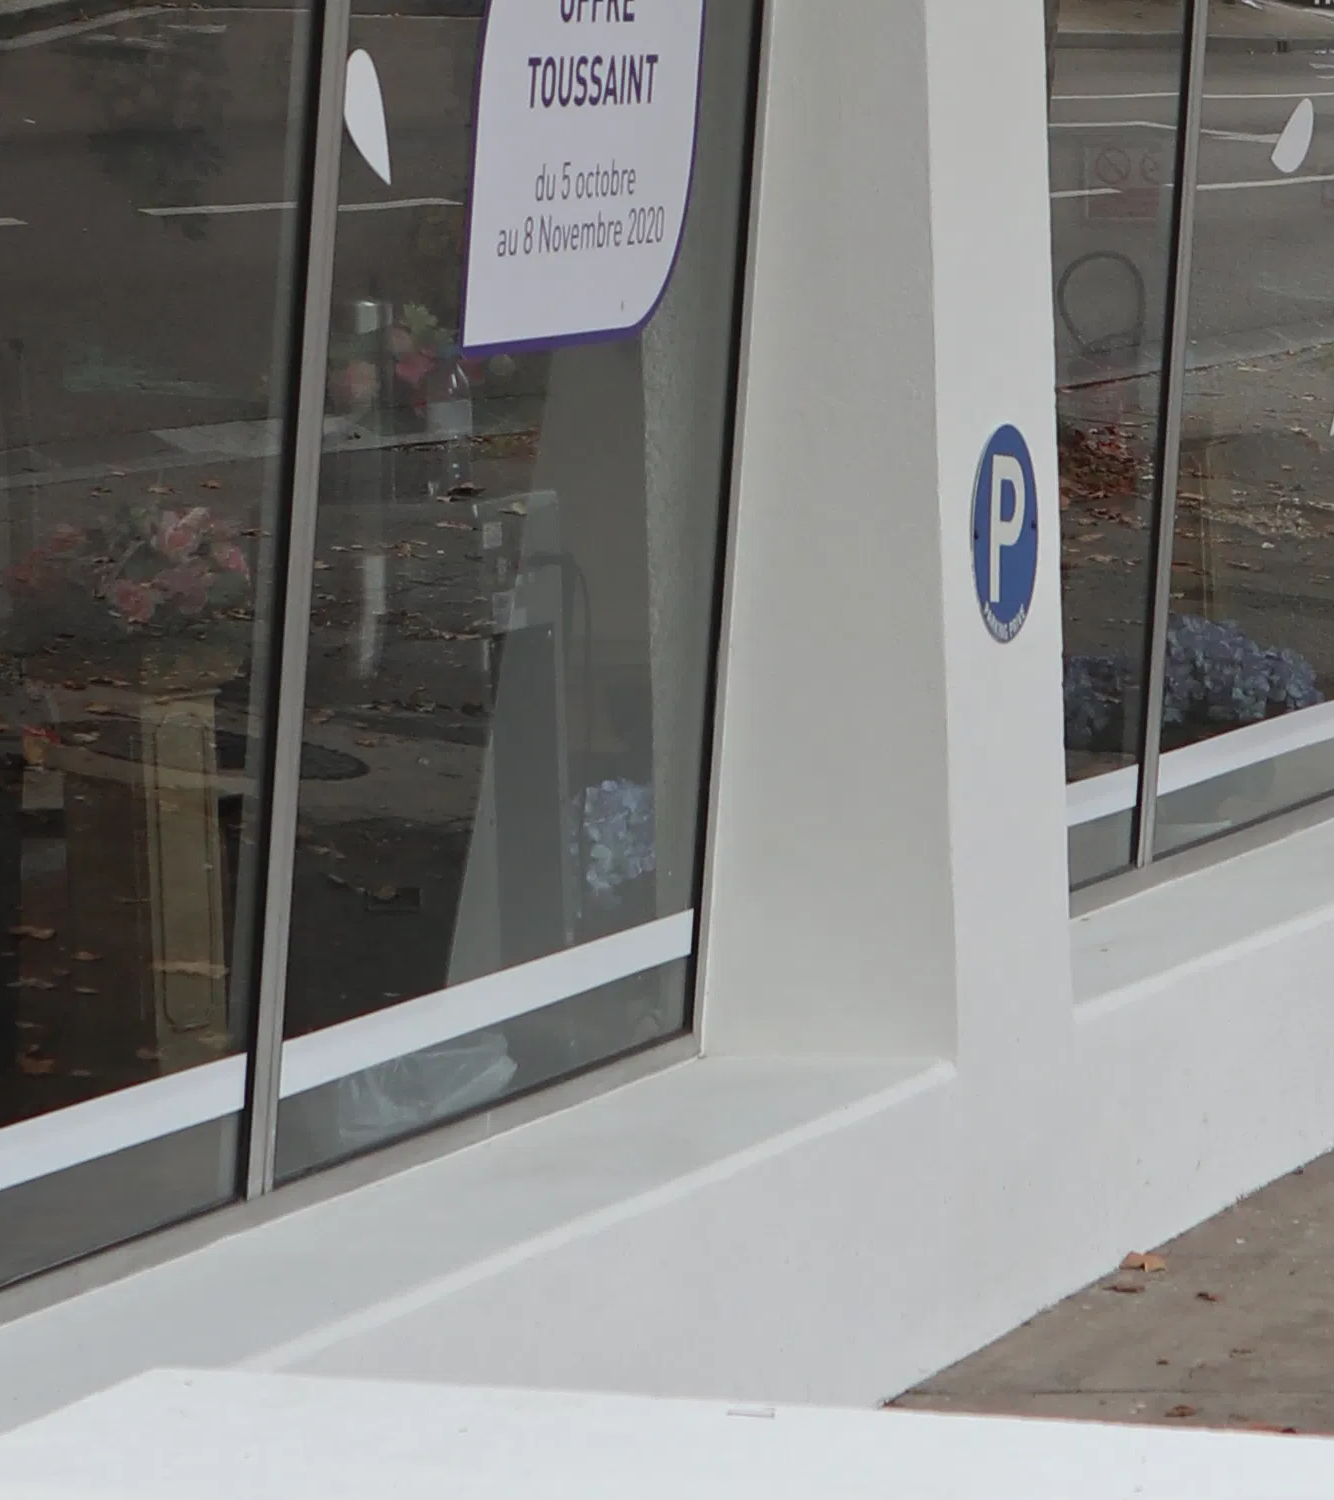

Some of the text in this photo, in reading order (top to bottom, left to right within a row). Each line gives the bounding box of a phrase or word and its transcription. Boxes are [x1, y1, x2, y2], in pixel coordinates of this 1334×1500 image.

[528, 54, 659, 109] TOUSSAINT
[535, 160, 637, 202] du 5 octobre
[497, 206, 665, 258] au 8 Novembre 2020
[989, 454, 1026, 603] P
